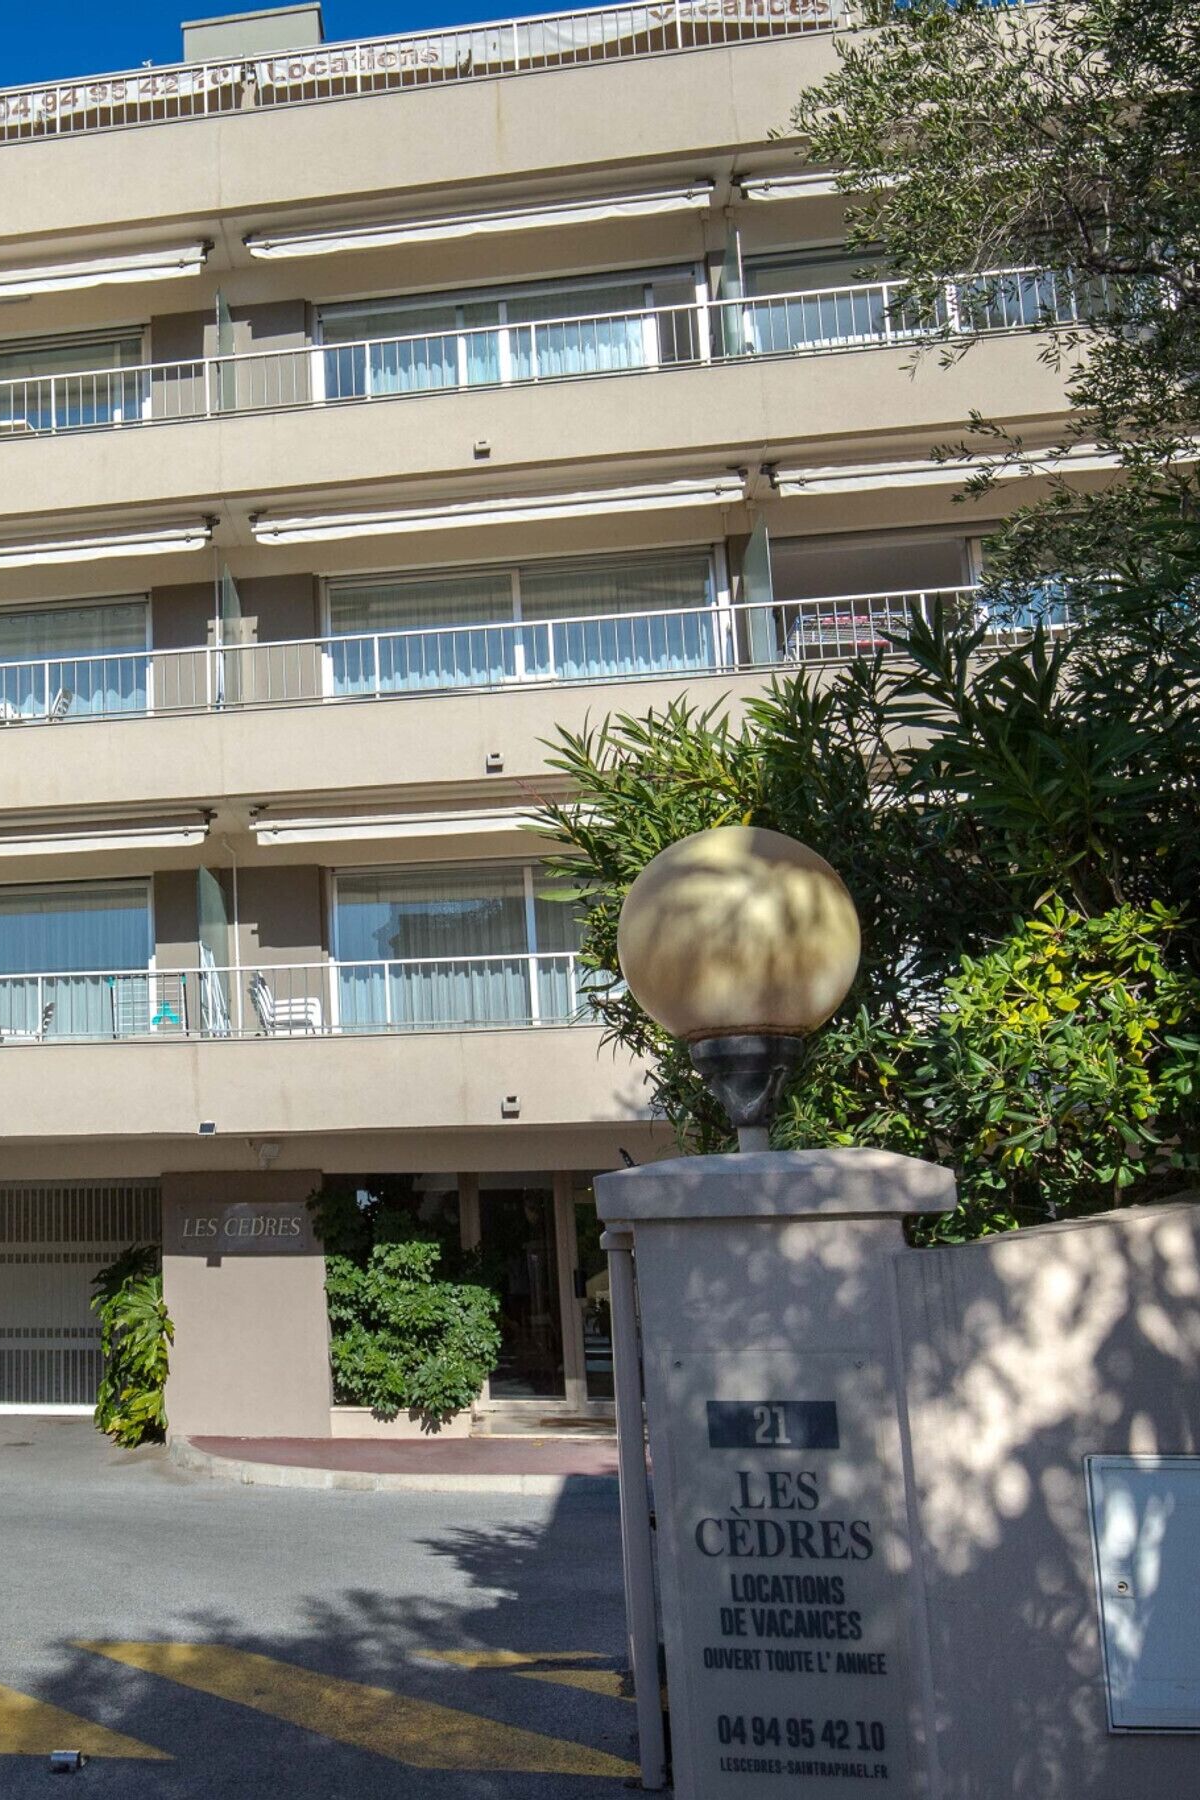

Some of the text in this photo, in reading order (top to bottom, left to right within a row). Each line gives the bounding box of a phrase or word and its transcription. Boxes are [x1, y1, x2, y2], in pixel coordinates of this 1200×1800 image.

[267, 46, 440, 82] Locations
[182, 1218, 219, 1237] LES
[753, 1405, 792, 1444] 21
[736, 1471, 820, 1511] LES
[695, 1506, 874, 1561] CÈDRES
[730, 1574, 845, 1605] LOCATIONS
[720, 1607, 862, 1640] DE VACANCES
[703, 1647, 761, 1671] OUVERT
[765, 1650, 815, 1673] TOUTE
[836, 1653, 887, 1675] ANNEE
[717, 1714, 885, 1752] 04 94 95 42 10
[720, 1756, 888, 1779] LESCEDRES-SAINTRAPHAEL.FR
